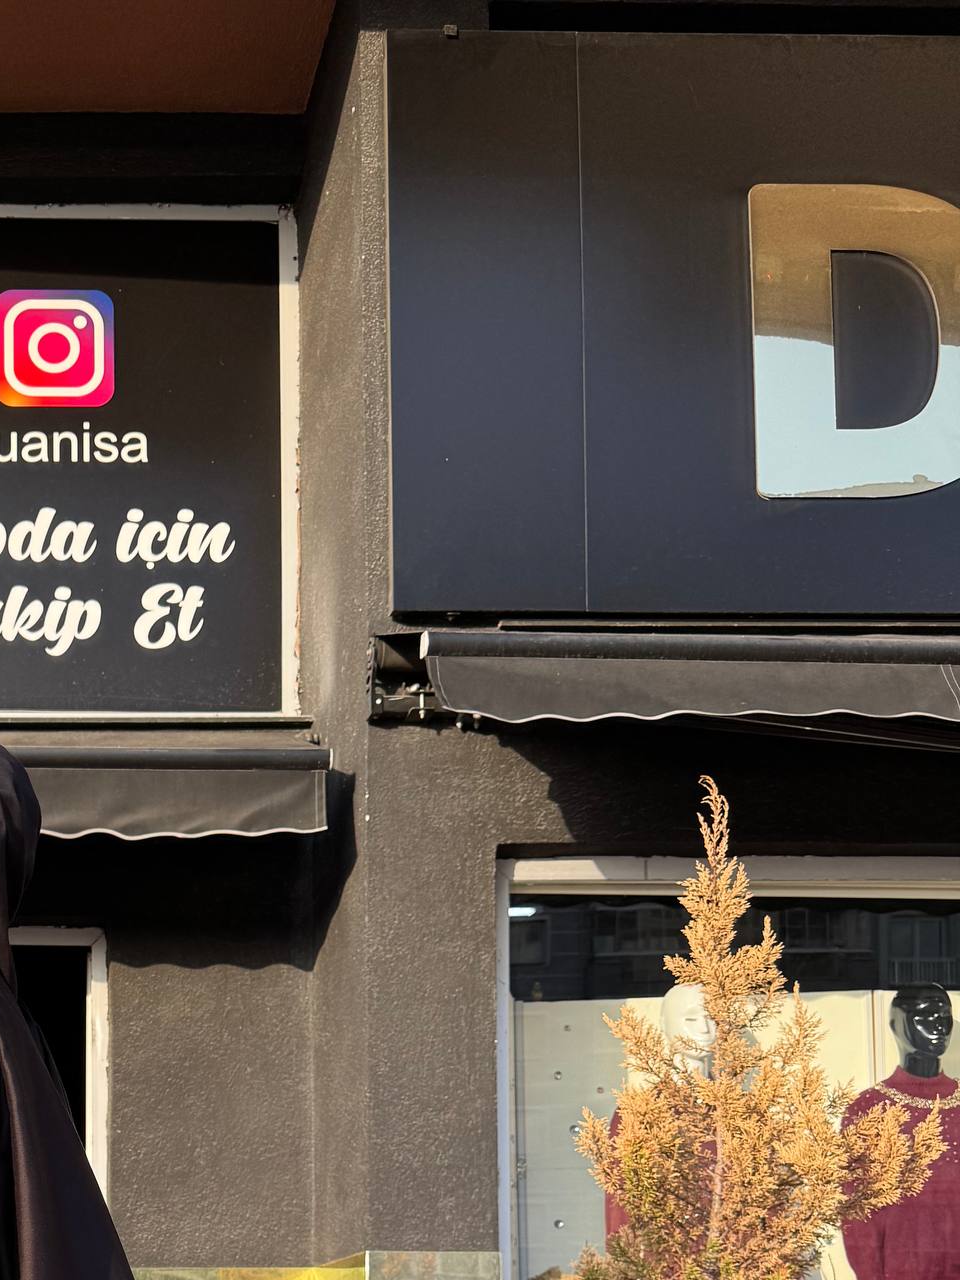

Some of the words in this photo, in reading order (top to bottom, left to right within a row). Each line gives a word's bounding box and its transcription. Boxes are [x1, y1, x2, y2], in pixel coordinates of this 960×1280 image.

[748, 183, 960, 499] D
[115, 507, 236, 570] için
[133, 582, 205, 650] Et
